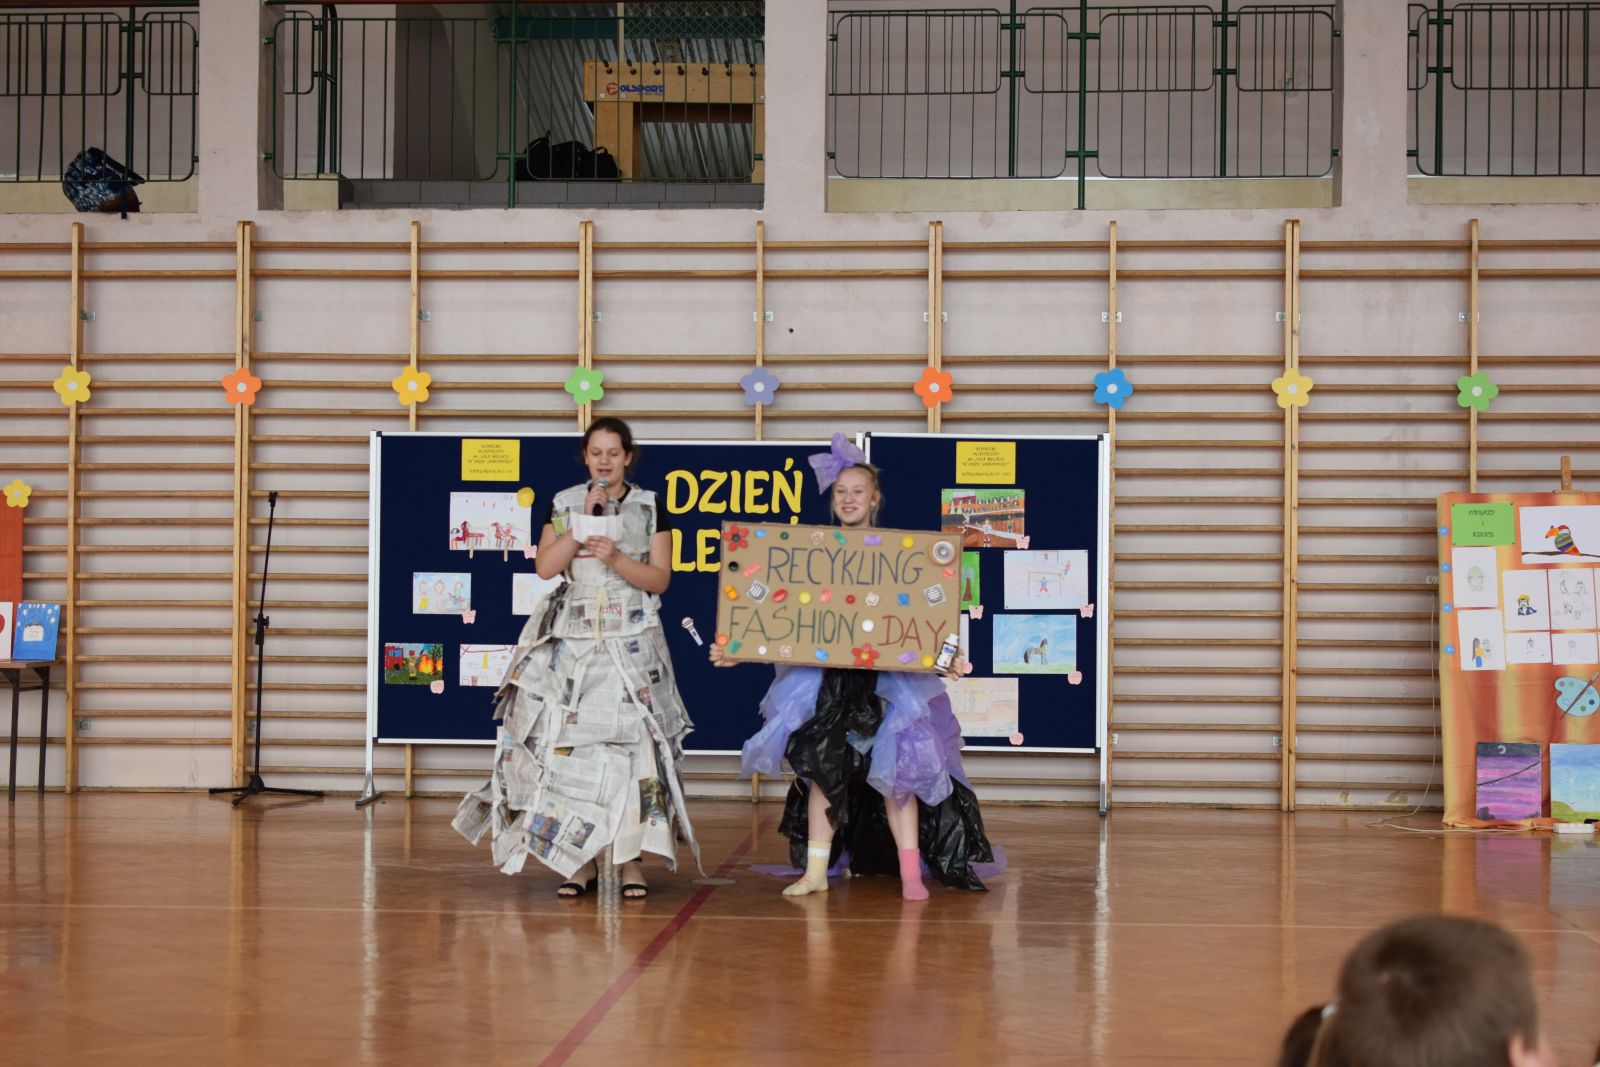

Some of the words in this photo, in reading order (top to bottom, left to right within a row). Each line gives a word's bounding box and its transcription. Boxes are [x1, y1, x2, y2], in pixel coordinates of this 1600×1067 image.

[665, 457, 803, 514] DZIEŃ
[671, 528, 721, 572] LE
[766, 546, 925, 586] RECYKLING
[729, 604, 859, 645] FASHION
[877, 614, 947, 654] DAY
